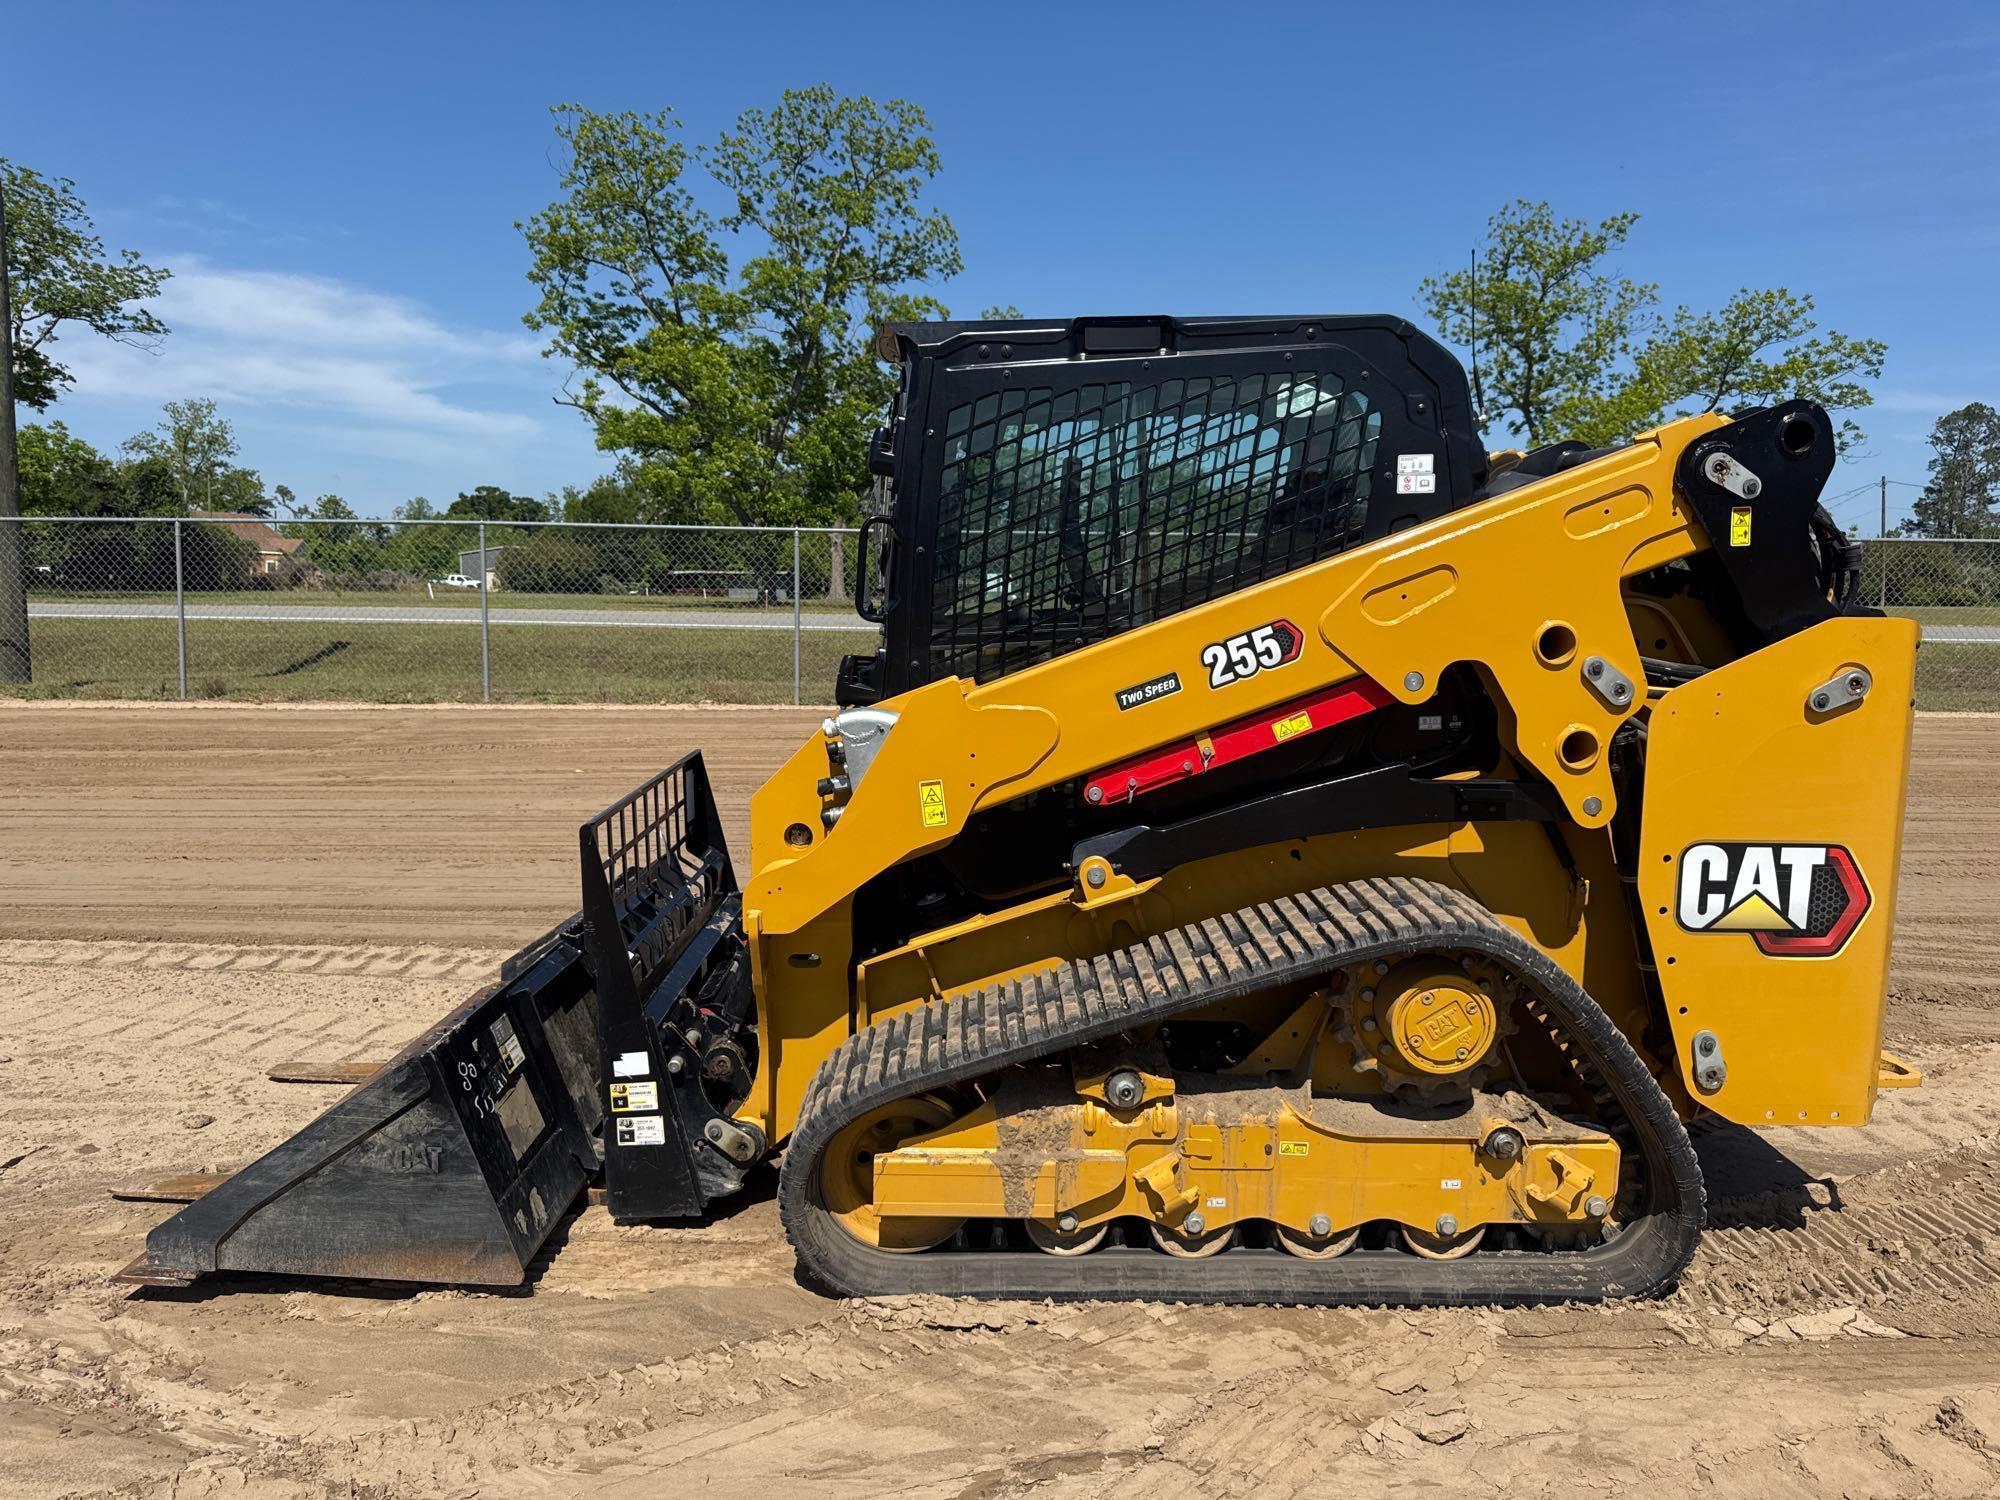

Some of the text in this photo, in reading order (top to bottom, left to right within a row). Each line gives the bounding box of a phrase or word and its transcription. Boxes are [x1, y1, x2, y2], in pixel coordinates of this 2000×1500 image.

[1203, 625, 1282, 686] 255
[1680, 845, 1827, 930] CAT
[1424, 1006, 1460, 1042] CAT
